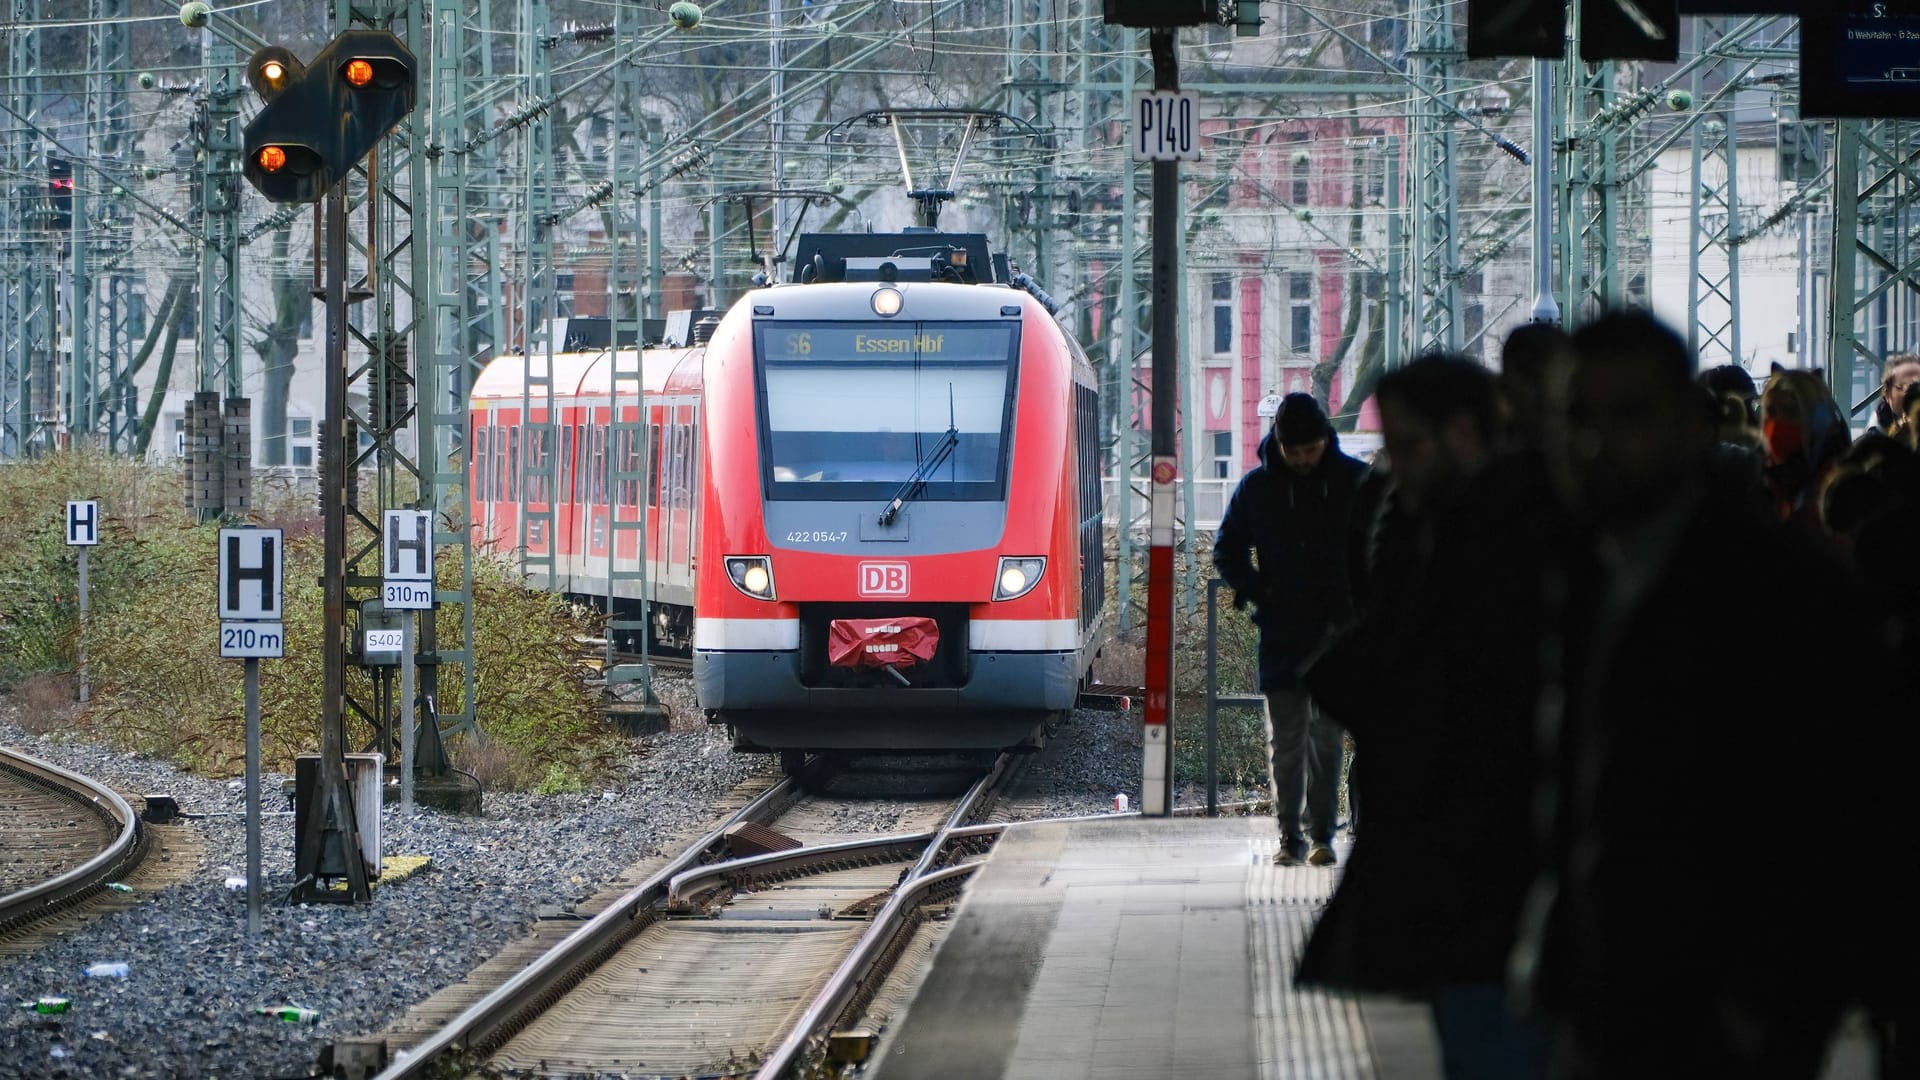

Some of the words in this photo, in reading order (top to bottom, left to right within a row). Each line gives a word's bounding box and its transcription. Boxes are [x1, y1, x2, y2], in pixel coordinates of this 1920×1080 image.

[1141, 97, 1191, 153] P140
[785, 333, 812, 355] S6
[855, 335, 910, 353] Essen
[913, 335, 944, 353] Hbf
[70, 504, 94, 541] H
[389, 515, 427, 574] H
[787, 531, 810, 543] 422
[812, 531, 848, 543] 054-7
[227, 536, 275, 611] H
[864, 566, 905, 592] DB
[386, 586, 412, 603] 310
[414, 590, 429, 603] m
[224, 628, 256, 649] 210
[260, 633, 280, 649] m
[369, 634, 402, 647] S402
